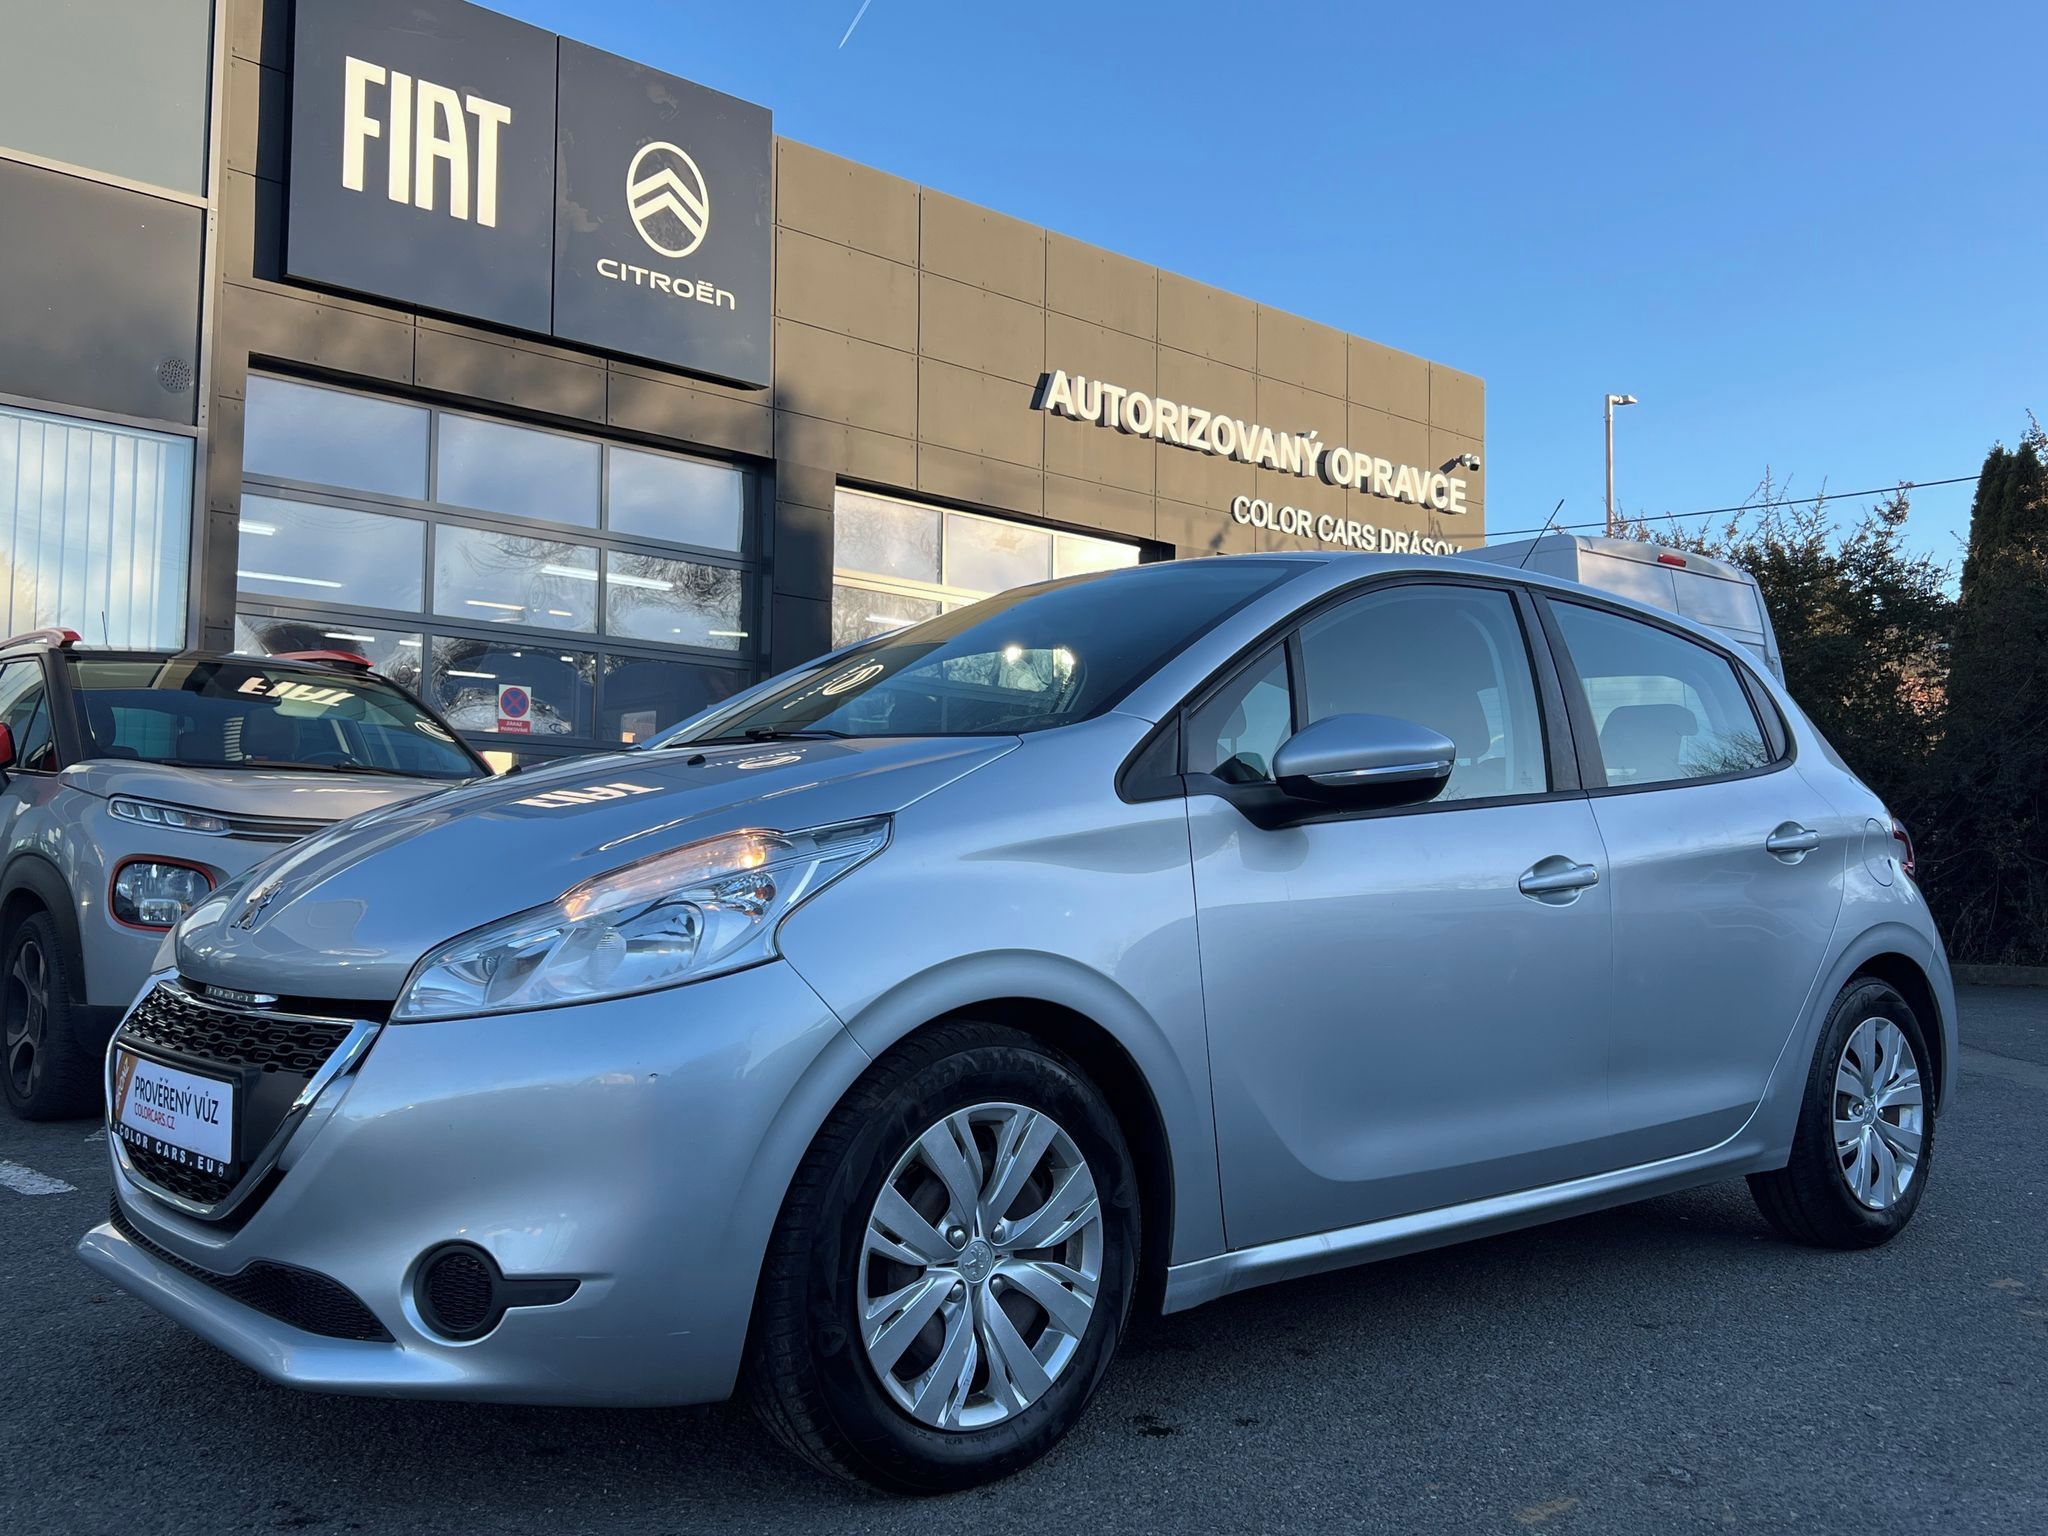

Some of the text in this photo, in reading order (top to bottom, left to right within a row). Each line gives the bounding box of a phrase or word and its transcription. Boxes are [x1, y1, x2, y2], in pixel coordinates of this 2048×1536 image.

[342, 56, 511, 228] FIAT
[597, 258, 736, 310] CITROËN
[1044, 369, 1468, 515] AUTORIZOVANÝ OPRAVCE
[1232, 495, 1314, 538] COLOR
[1317, 513, 1376, 551] CARS
[134, 1102, 176, 1130] COLORCARS.CZ
[135, 1075, 192, 1117] PROVĚŘENÝ
[194, 1091, 219, 1125] VŮZ
[119, 1124, 148, 1149] COLOR
